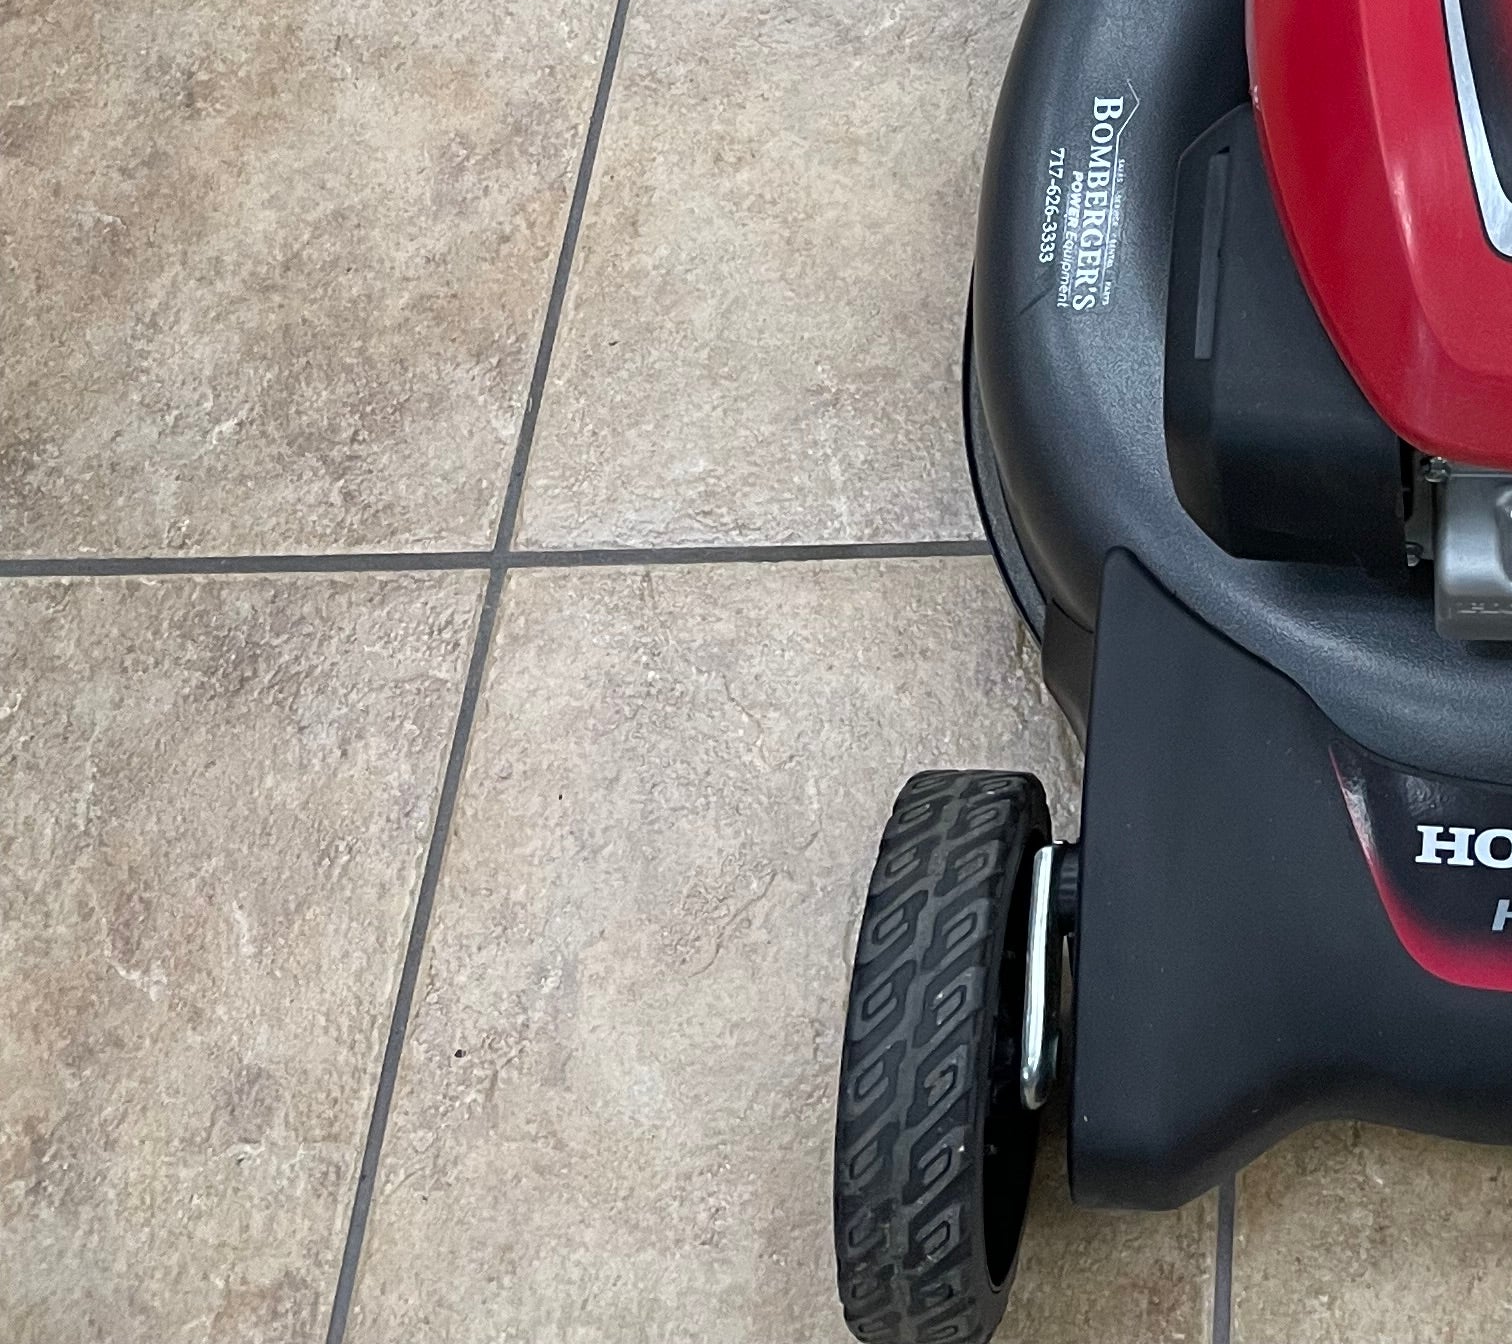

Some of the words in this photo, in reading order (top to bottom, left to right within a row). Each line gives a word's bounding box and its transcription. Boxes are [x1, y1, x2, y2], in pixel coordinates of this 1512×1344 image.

[1038, 147, 1065, 263] 717-626-3333
[1063, 170, 1084, 229] POWER
[1072, 96, 1124, 311] BOMBERGER'S
